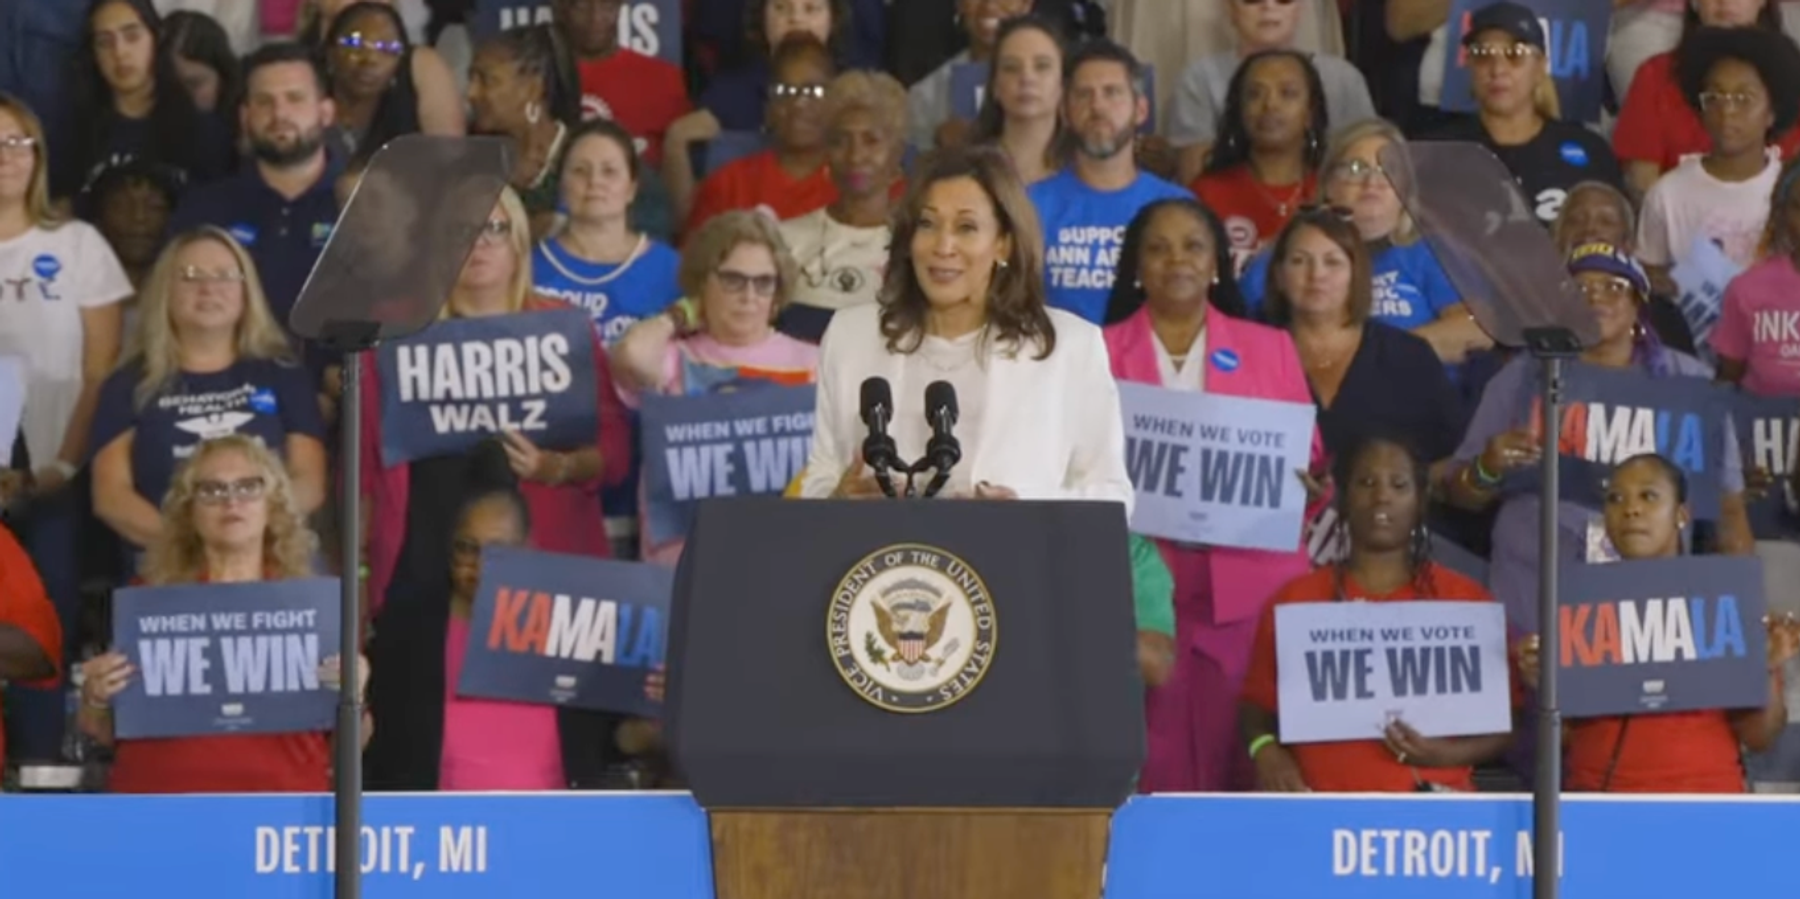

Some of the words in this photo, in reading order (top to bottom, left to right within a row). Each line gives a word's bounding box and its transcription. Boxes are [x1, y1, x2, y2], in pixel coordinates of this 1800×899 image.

[1046, 245, 1090, 266] ANN
[397, 332, 572, 402] HARRIS
[429, 399, 548, 434] WALZ
[665, 421, 730, 443] WHEN
[733, 416, 768, 436] WE
[1133, 413, 1194, 438] WHEN
[1200, 423, 1231, 442] WE
[1237, 428, 1285, 448] VOTE
[665, 444, 736, 500] WE
[1126, 436, 1189, 498] WE
[1200, 448, 1285, 509] WIN
[884, 552, 903, 567] OF
[911, 551, 940, 567] THE
[139, 613, 207, 633] WHEN
[210, 612, 248, 631] WE
[252, 608, 317, 629] FIGHT
[832, 559, 878, 656] PRESIDENT
[946, 560, 992, 630] UNITED
[486, 585, 665, 668] KAMALA
[1309, 628, 1374, 643] WHEN
[1380, 627, 1413, 641] WE
[1420, 625, 1476, 640] VOTE
[1559, 594, 1747, 668] KAMALA
[138, 637, 211, 697] WE
[220, 633, 320, 694] WIN
[846, 661, 883, 701] VICE
[939, 639, 991, 701] STATES
[1304, 648, 1375, 702] WE
[1385, 645, 1482, 697] WIN
[438, 825, 487, 873] MI
[1332, 828, 1502, 884] DETROIT,
